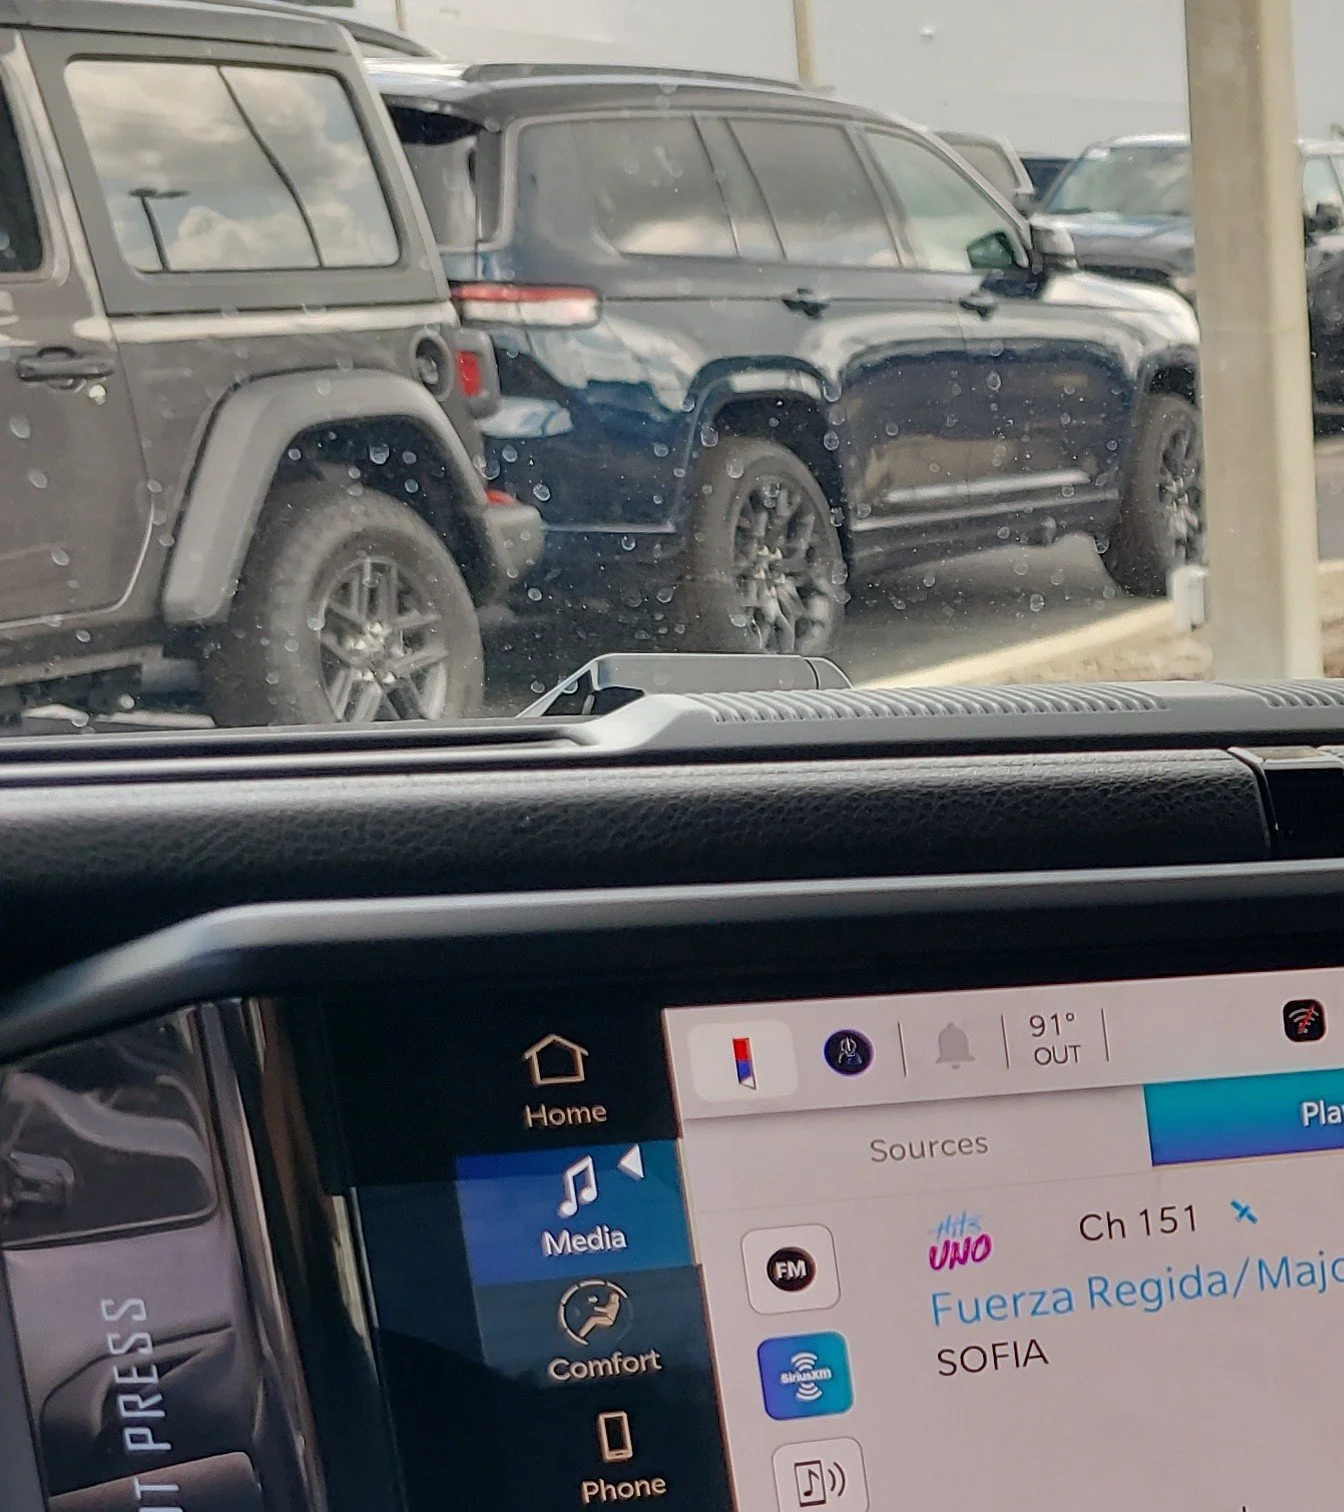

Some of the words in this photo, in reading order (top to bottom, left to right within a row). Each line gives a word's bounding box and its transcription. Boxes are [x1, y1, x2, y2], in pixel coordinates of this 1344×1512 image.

[1034, 1044, 1081, 1066] OUT
[525, 1102, 607, 1126] Home
[870, 1132, 989, 1164] Sources
[1079, 1211, 1126, 1241] Ch
[1140, 1205, 1196, 1236] 151
[543, 1227, 627, 1257] Media
[929, 1234, 991, 1271] UNO
[775, 1260, 806, 1280] FM
[932, 1288, 1073, 1326] Fuerza
[549, 1349, 662, 1382] Comfort
[937, 1339, 1048, 1376] SOFIA
[101, 1297, 171, 1452] PRESS
[582, 1476, 666, 1504] Phone
